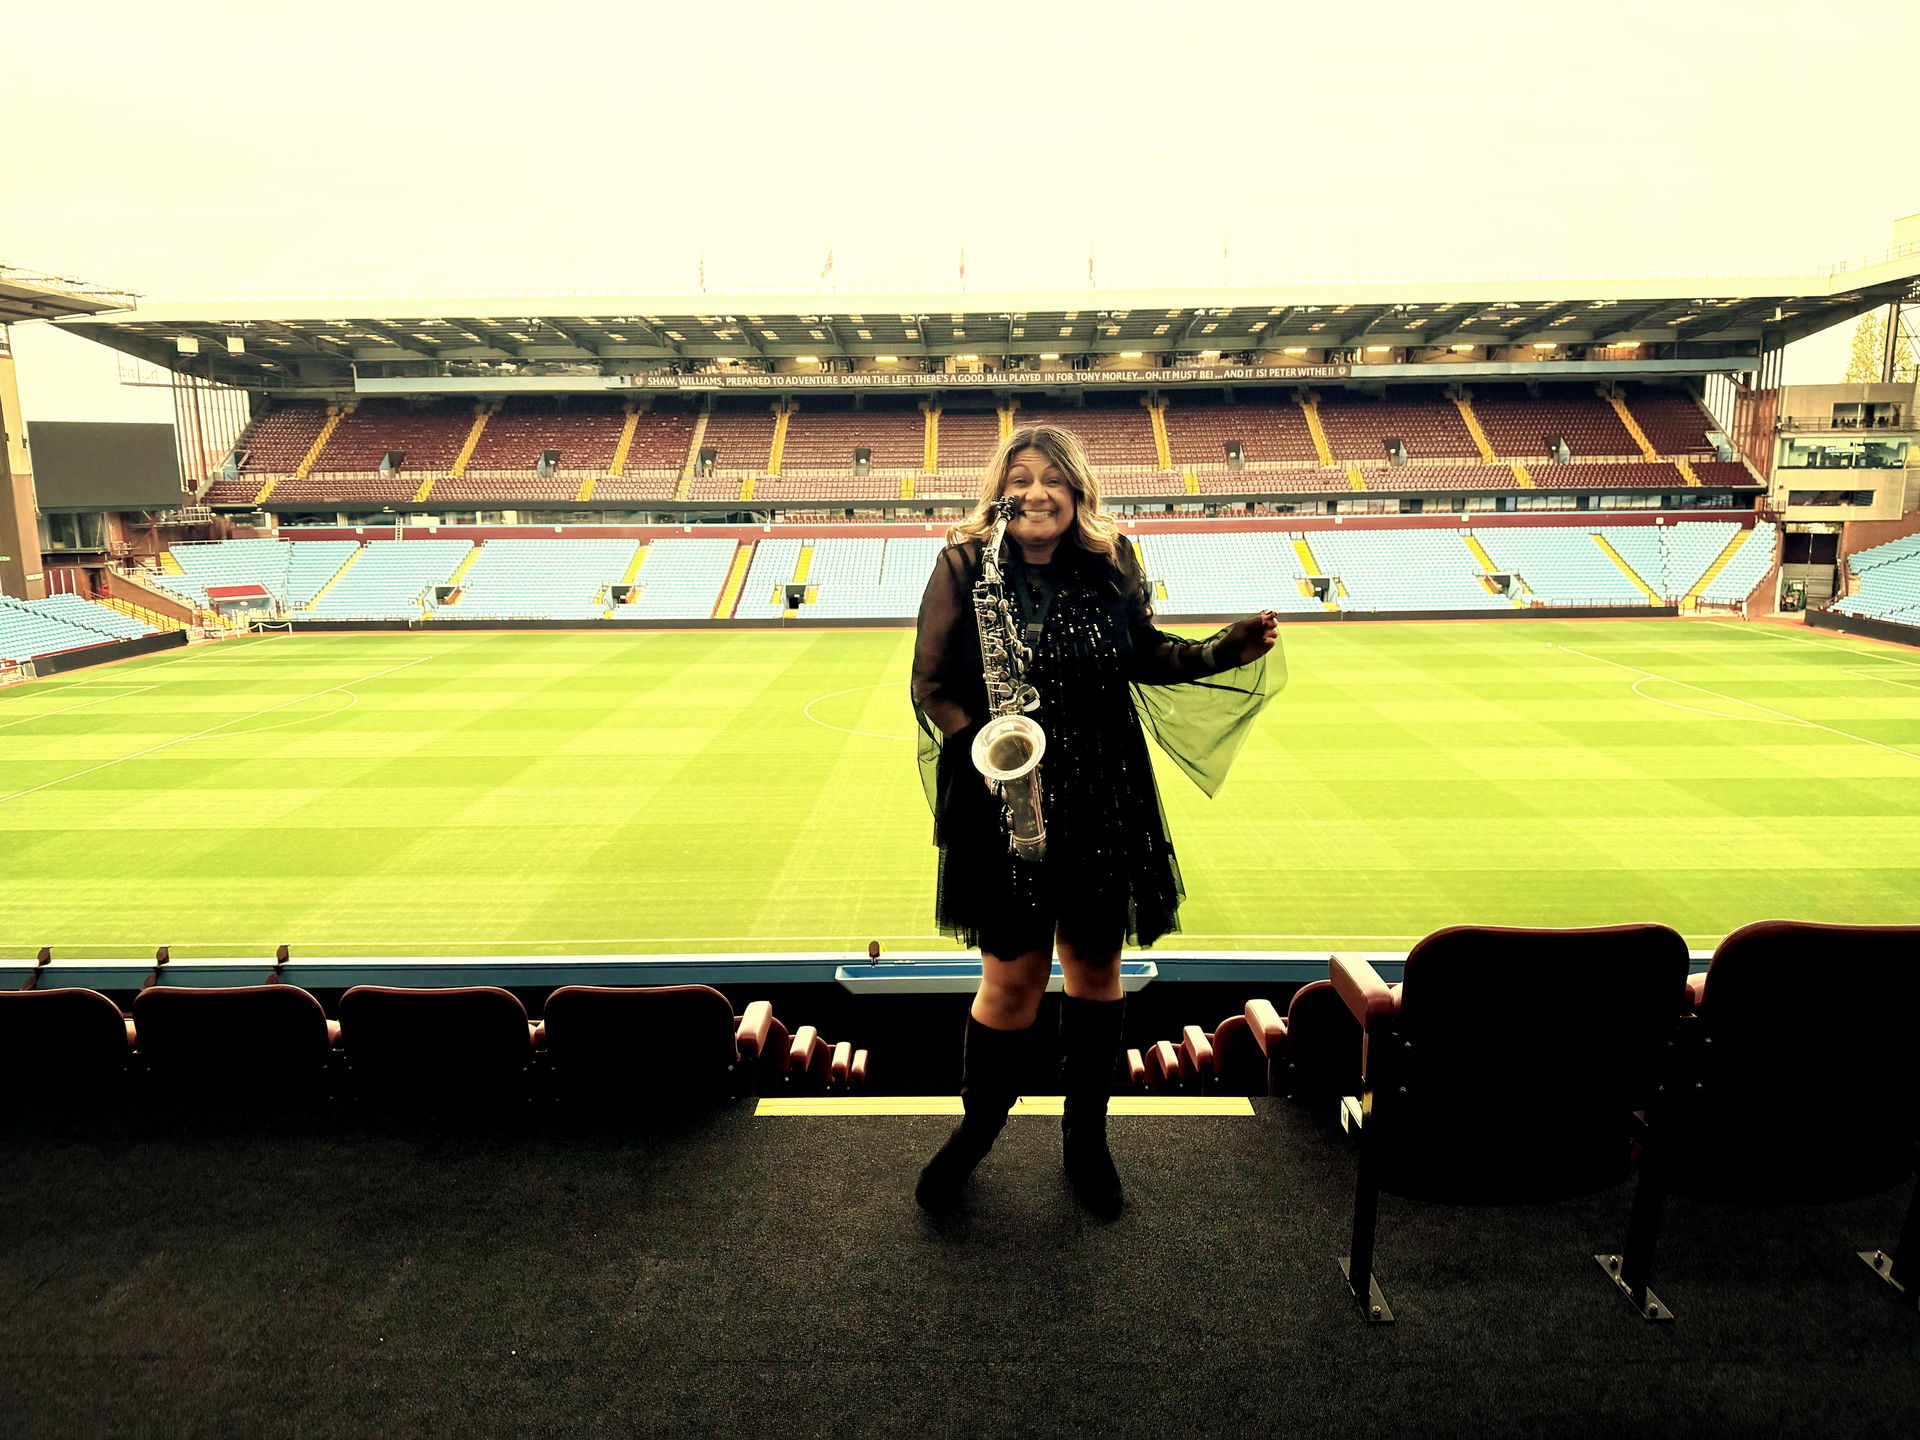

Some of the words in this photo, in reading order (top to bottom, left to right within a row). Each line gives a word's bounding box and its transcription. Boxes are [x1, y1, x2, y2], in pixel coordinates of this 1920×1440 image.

[648, 376, 677, 386] SHAW,
[678, 376, 724, 386] WILLIAMS,
[726, 376, 770, 385] PREPARED
[772, 376, 785, 384] TO
[786, 376, 838, 384] ADVENTURE
[841, 376, 871, 384] DOWN
[872, 375, 890, 384] THE
[914, 374, 949, 383] THERE'S
[950, 374, 957, 382] A
[958, 374, 984, 382] GOOD
[986, 374, 1009, 382] BALL
[1009, 374, 1041, 382] PLAYED
[1044, 374, 1054, 382] IN
[1056, 373, 1074, 382] FOR
[1076, 372, 1101, 381] TONY
[1145, 371, 1162, 380] OH,
[1162, 371, 1172, 379] IT
[1172, 370, 1198, 379] MUST
[1245, 370, 1254, 378] IT
[1269, 368, 1296, 376] PETER
